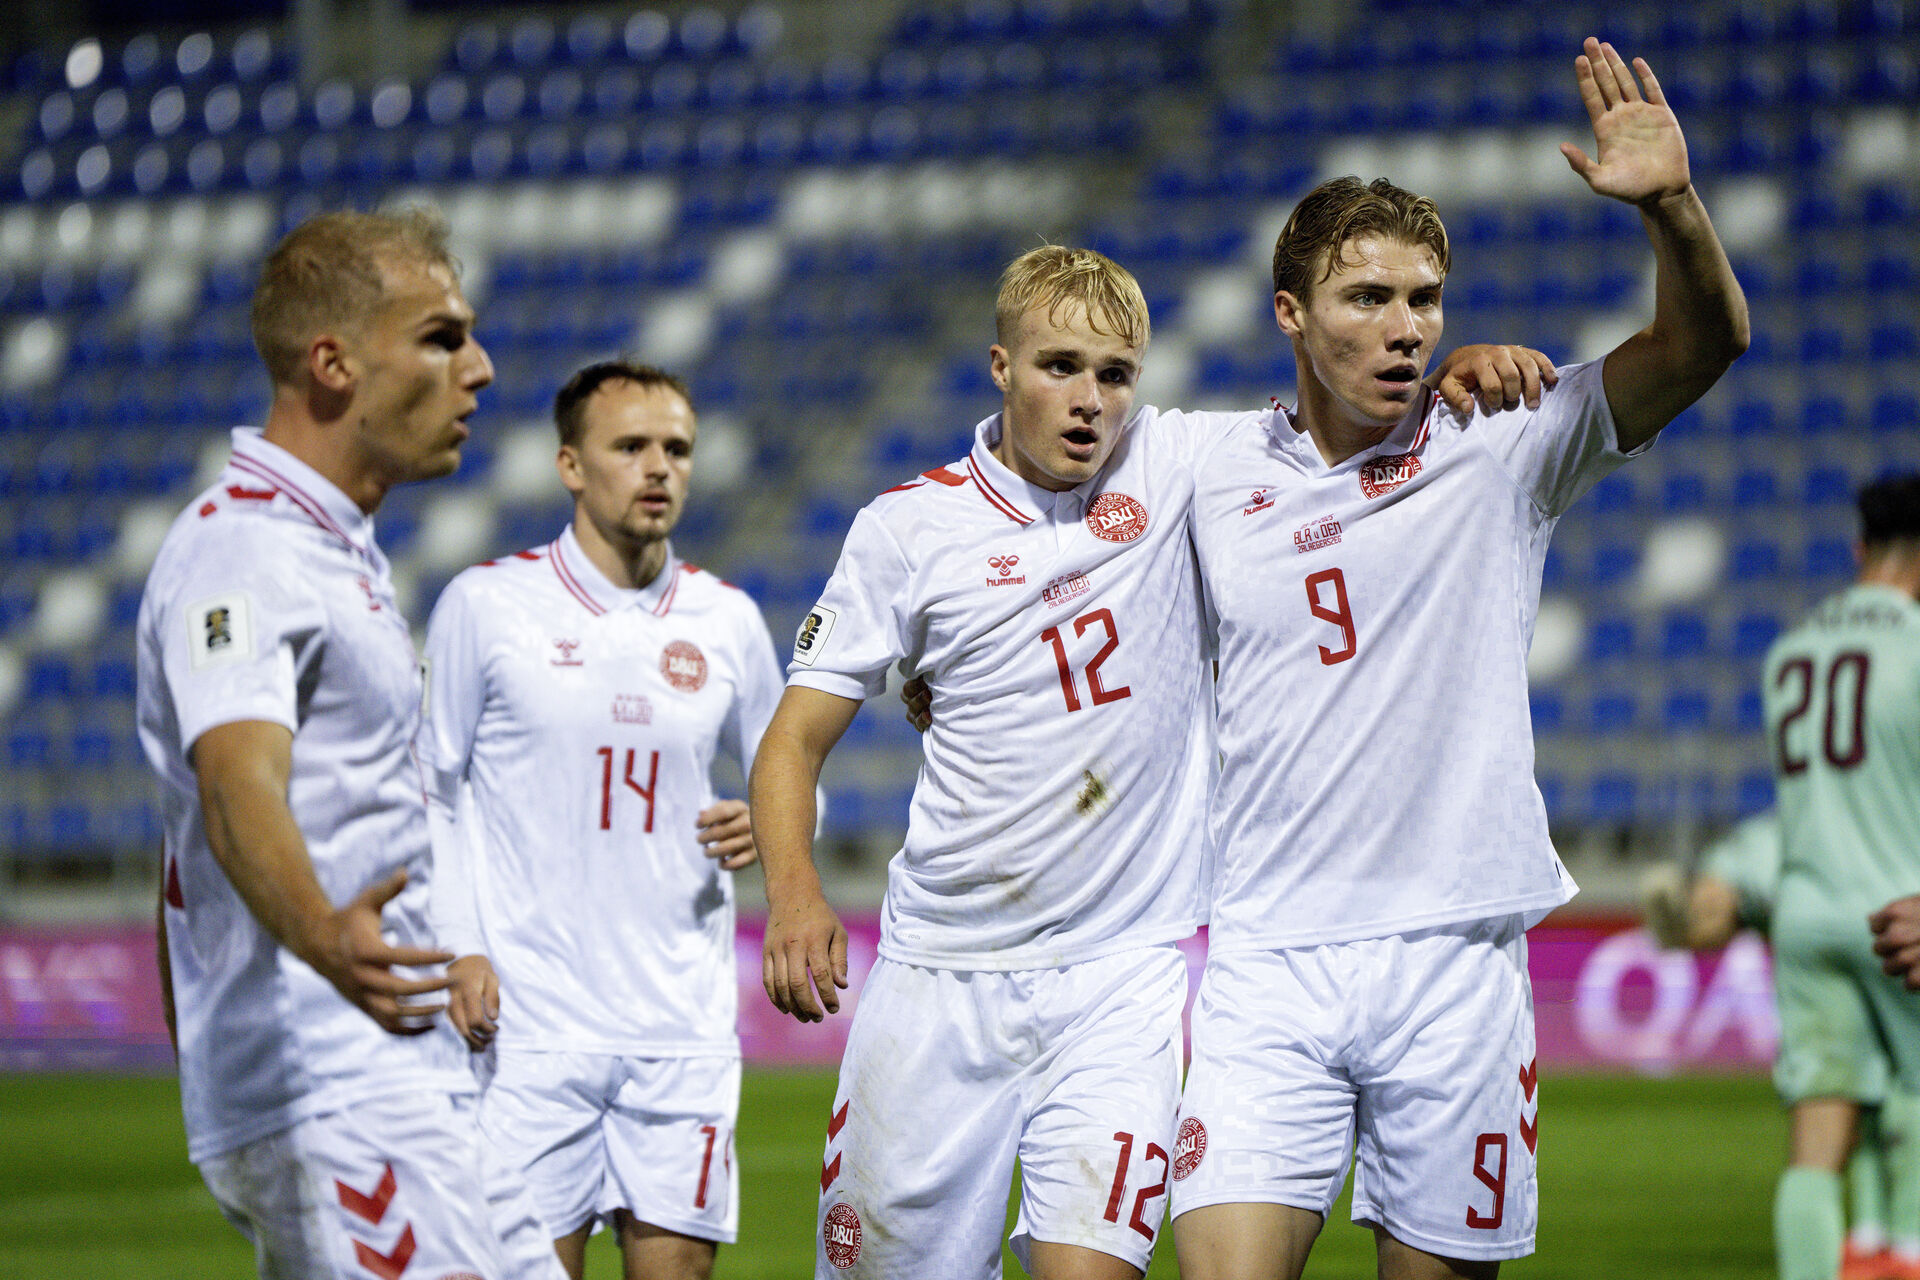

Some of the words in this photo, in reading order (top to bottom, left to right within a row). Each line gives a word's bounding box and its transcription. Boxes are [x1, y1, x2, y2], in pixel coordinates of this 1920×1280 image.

[1372, 465, 1411, 485] DBU
[1097, 505, 1137, 530] DBU
[1293, 528, 1312, 545] BLR
[1320, 521, 1342, 538] DEN
[985, 575, 1027, 588] hummel
[1042, 584, 1062, 603] BLR
[1304, 567, 1357, 666] 9
[1041, 607, 1132, 713] 12
[1775, 651, 1871, 779] 20
[596, 746, 661, 834] 14
[1103, 1130, 1170, 1243] 12
[1465, 1132, 1508, 1230] 9
[831, 1223, 854, 1247] DBU
